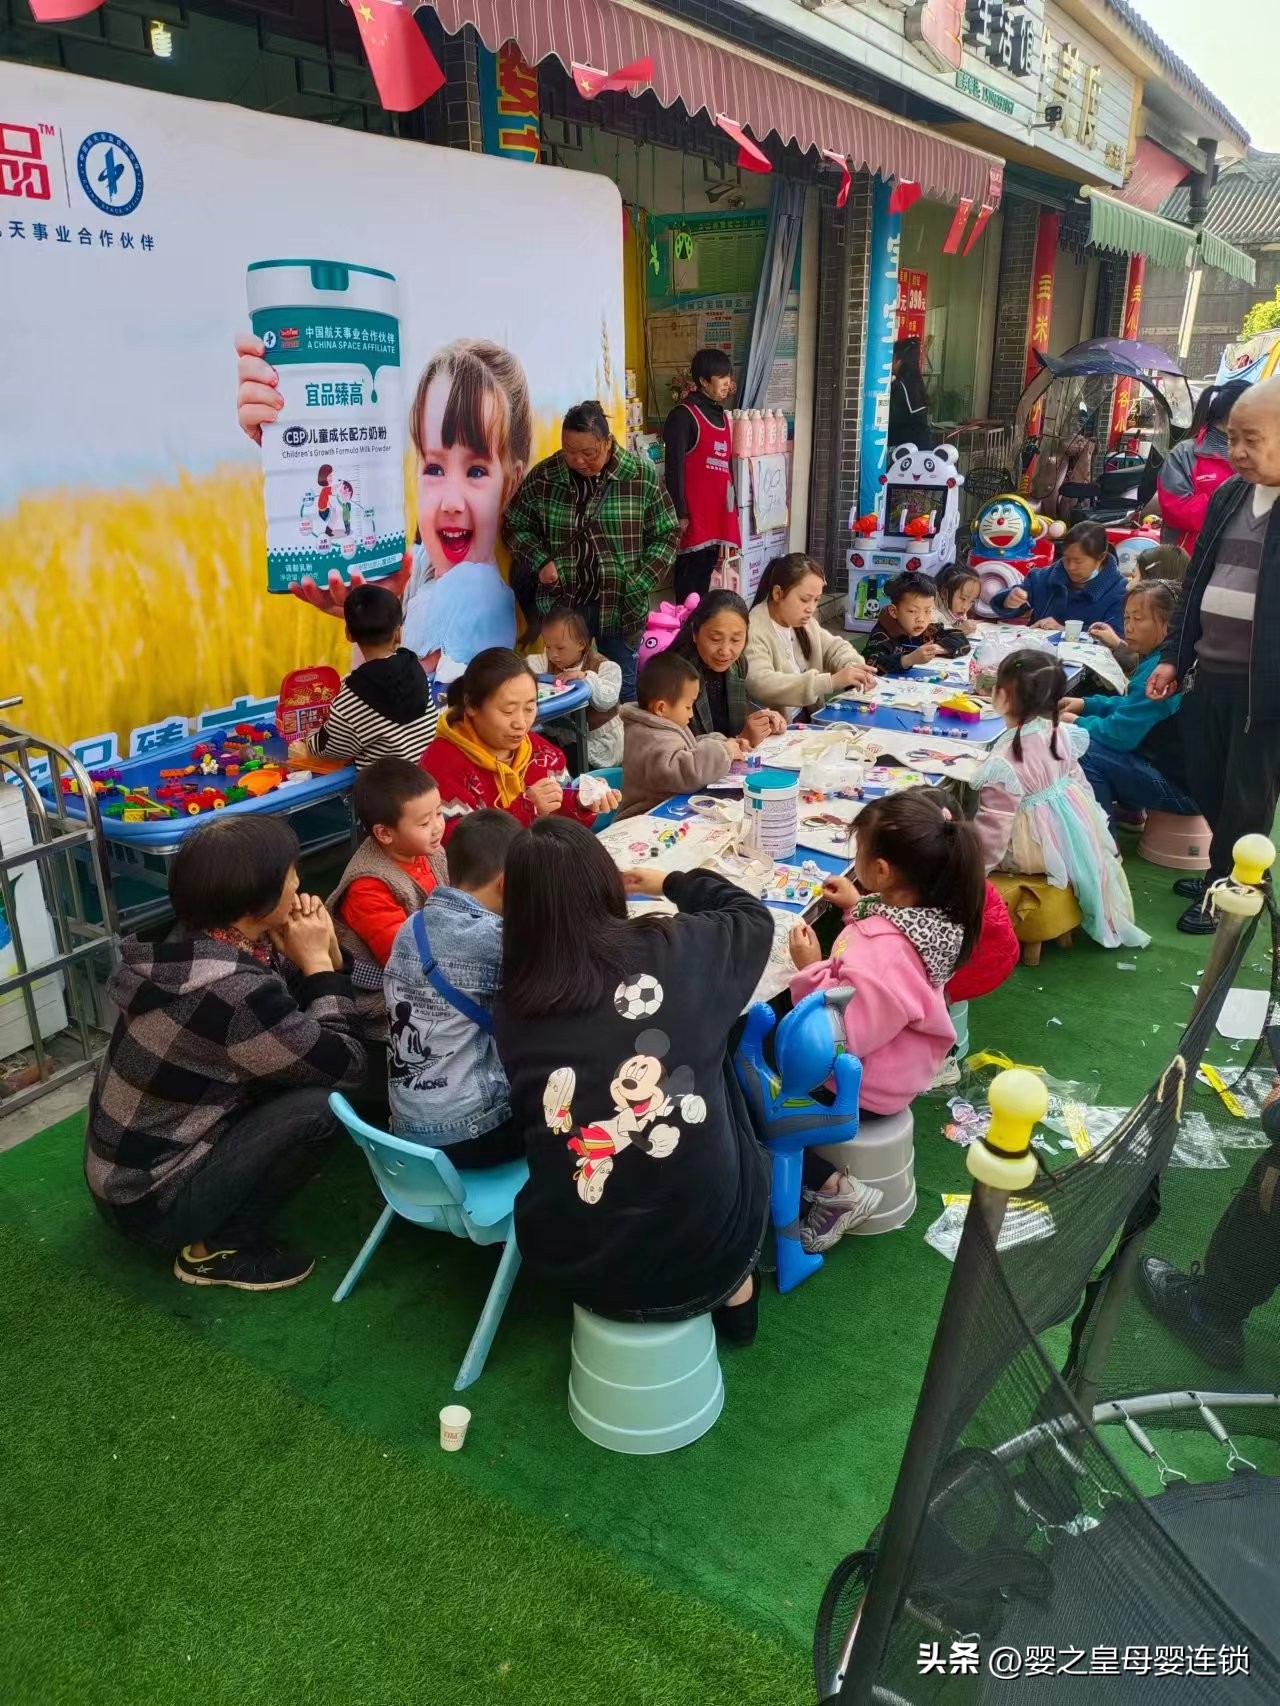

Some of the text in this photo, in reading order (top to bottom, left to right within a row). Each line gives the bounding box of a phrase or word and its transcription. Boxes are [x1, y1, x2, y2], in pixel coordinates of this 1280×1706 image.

[38, 123, 55, 136] TM
[0, 220, 155, 251] 天事业合作伙伴
[305, 325, 396, 345] 中国航天事业合作伙伴
[307, 340, 396, 354] A CHINA SPACE AFFILIATE
[305, 382, 363, 407] 宜品臻高
[284, 426, 387, 444] CBP 儿童成长配方奶粉
[282, 445, 392, 459] Children's Growth Formula Milk Powder
[414, 1077, 448, 1091] MICKEY
